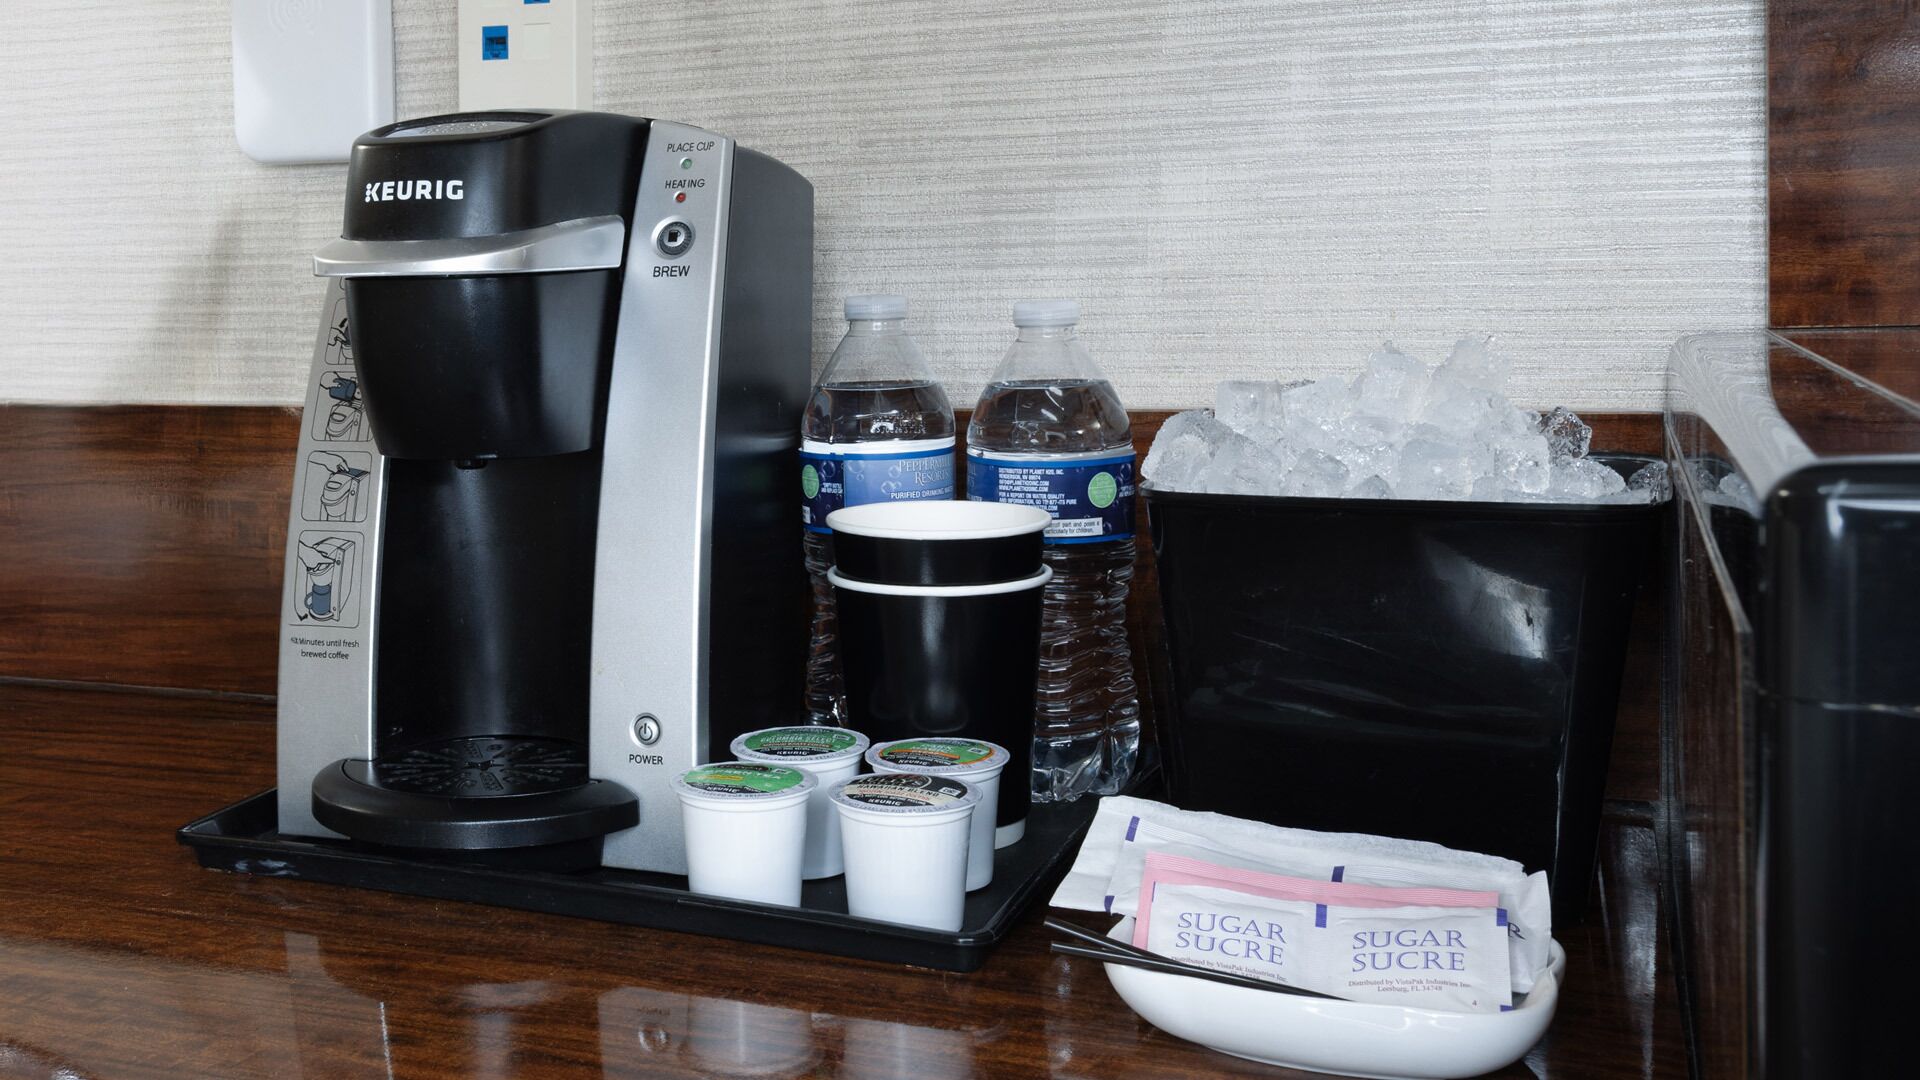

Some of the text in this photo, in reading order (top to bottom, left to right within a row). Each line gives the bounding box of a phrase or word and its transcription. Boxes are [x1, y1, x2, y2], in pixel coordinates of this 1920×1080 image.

[666, 140, 715, 153] PLACE CUP
[665, 178, 706, 189] HEATING
[364, 180, 464, 203] KEURIG
[652, 265, 691, 278] BREW
[891, 490, 920, 499] PURIFIED
[299, 637, 325, 647] Minutes
[342, 640, 360, 648] fresh
[300, 649, 350, 660] brewed coffee
[629, 754, 664, 765] POWER
[907, 787, 940, 797] BLEND
[868, 798, 901, 806] KEURIG
[1177, 912, 1288, 944] SUGAR
[1352, 930, 1467, 949] SUGAR
[1175, 931, 1284, 966] SUCRE
[1352, 951, 1465, 973] SUCRE
[1348, 979, 1385, 987] Distributed
[1425, 979, 1458, 987] Industries
